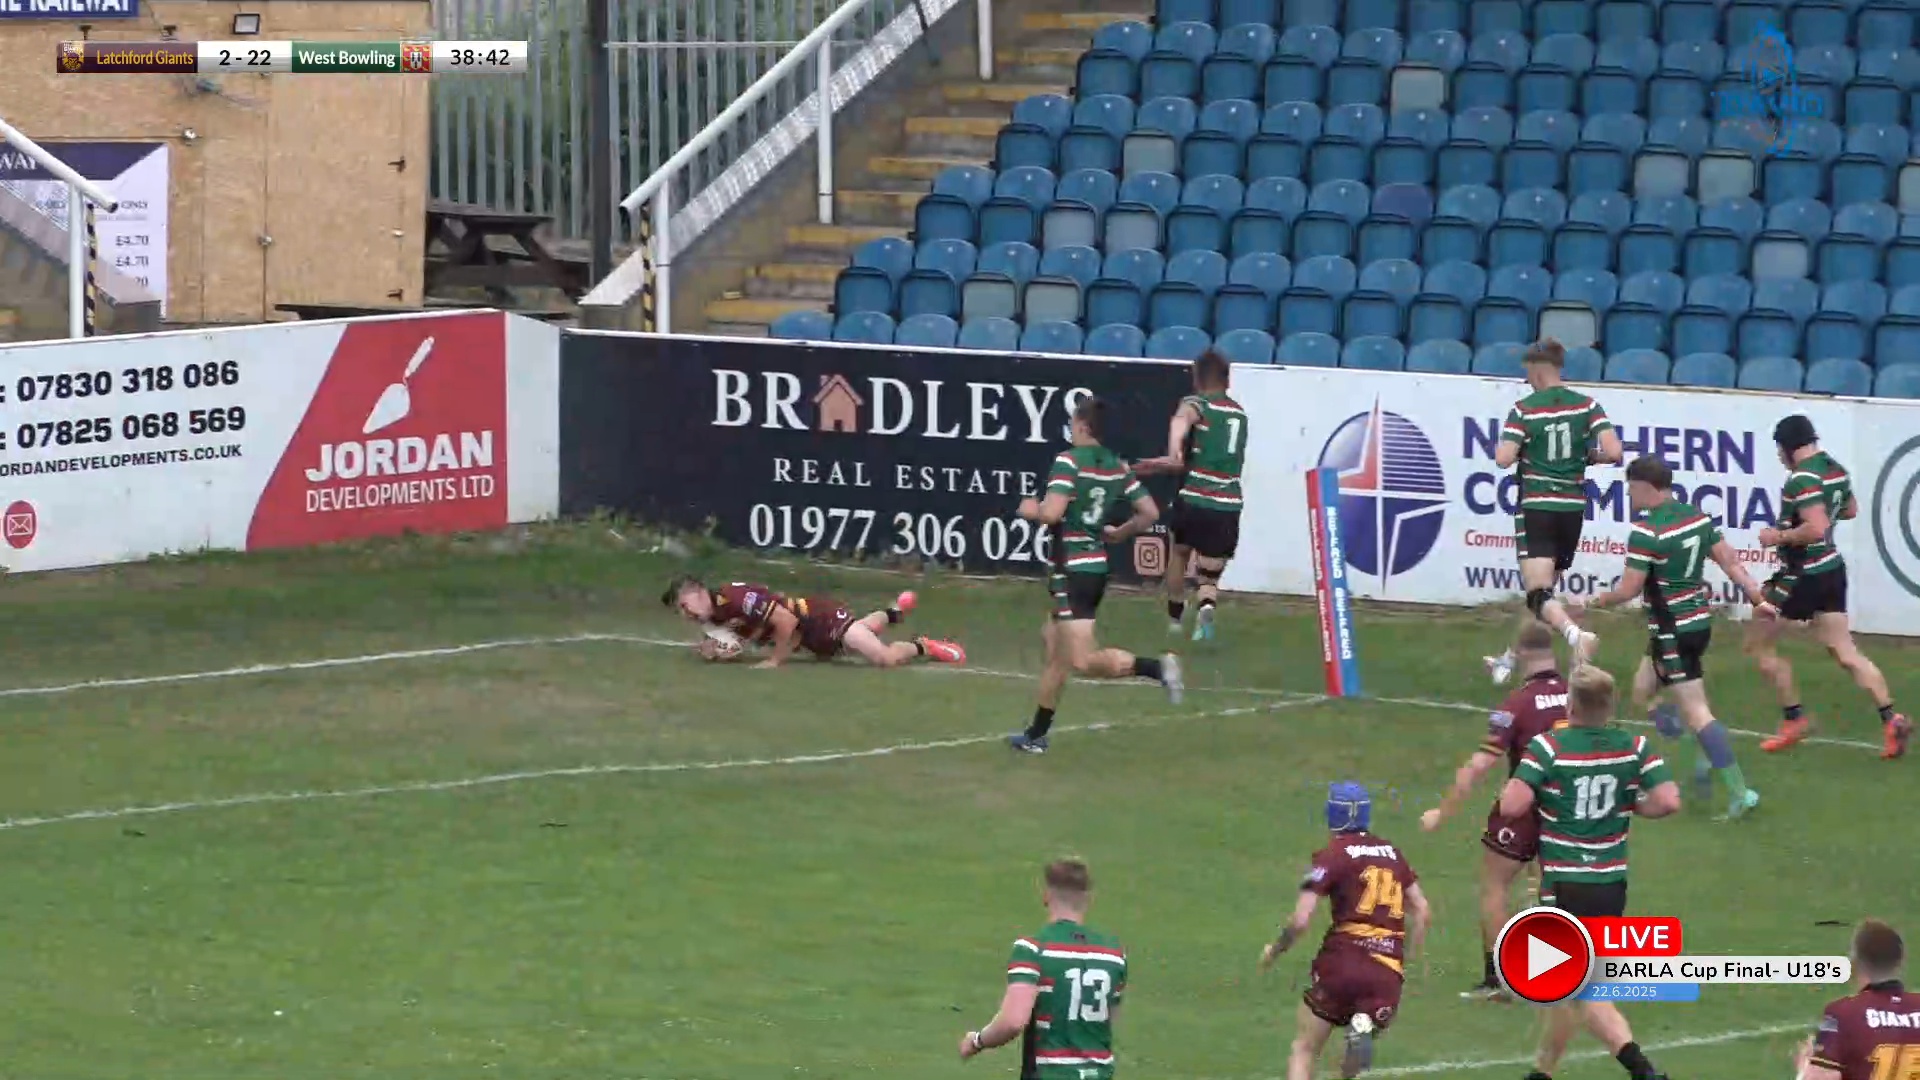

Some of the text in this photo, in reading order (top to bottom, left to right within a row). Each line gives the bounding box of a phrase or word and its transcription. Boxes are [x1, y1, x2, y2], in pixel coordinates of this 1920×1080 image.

[16, 370, 113, 402] 07830
[121, 365, 174, 393] 318
[183, 360, 239, 388] 086
[16, 417, 113, 448] 07825
[122, 412, 180, 440] 068
[188, 406, 246, 434] 569
[1227, 418, 1240, 454] 1
[1463, 416, 1755, 475] NHERN
[1543, 422, 1572, 462] 11
[304, 430, 494, 482] JORDAN
[773, 457, 1038, 497] REAL ESTATE
[306, 475, 495, 512] DEVELOPMENTS LTD
[1081, 486, 1107, 525] 3
[750, 503, 1056, 567] 01977 306 026
[1681, 535, 1701, 578] 7
[1573, 773, 1618, 820] 10
[1355, 864, 1405, 919] 14
[1064, 967, 1111, 1022] 13
